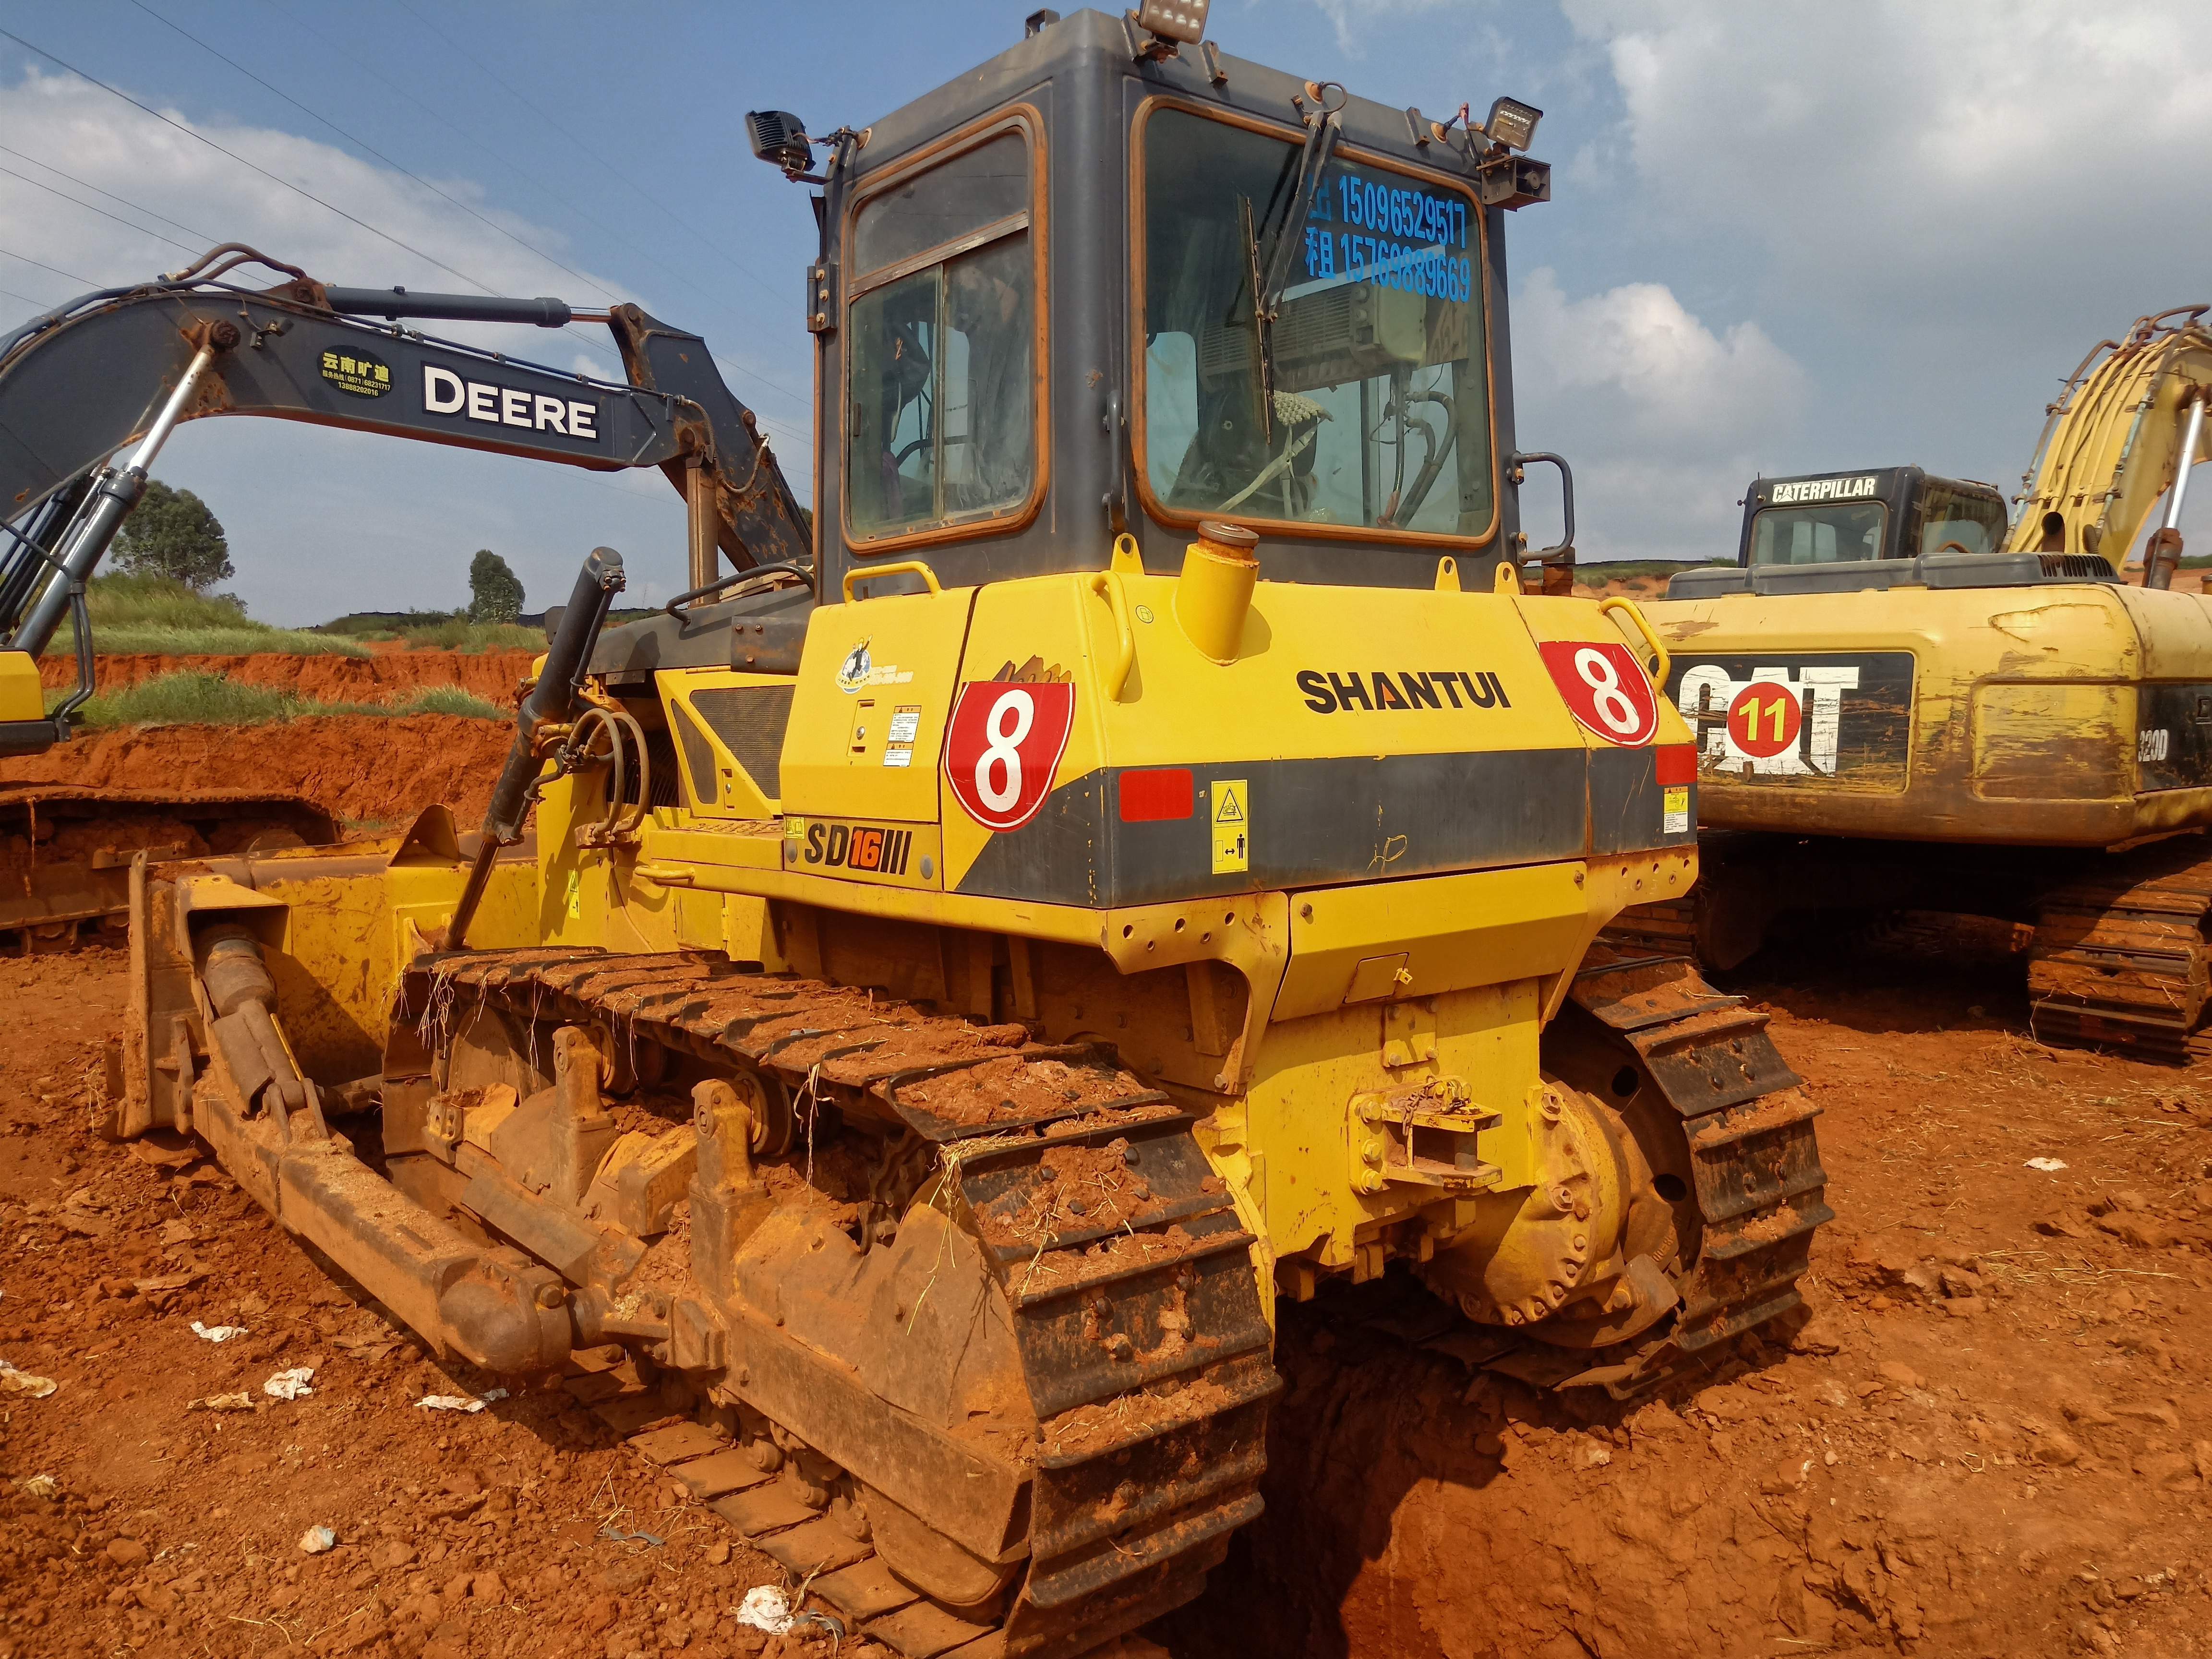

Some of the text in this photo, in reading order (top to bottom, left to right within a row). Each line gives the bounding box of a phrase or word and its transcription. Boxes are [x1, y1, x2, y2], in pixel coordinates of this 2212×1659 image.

[1339, 175, 1466, 249] 15096529517
[1305, 227, 1470, 302] 租 15769889669
[323, 352, 389, 382] 云南旷迪
[338, 382, 379, 396] 13888202016
[425, 366, 596, 439] DEERE
[1772, 478, 1875, 503] CATERPILLAR
[1296, 670, 1512, 714] SHANTUI
[1575, 648, 1640, 734] 8
[1738, 697, 1786, 742] 11
[975, 689, 1034, 812] 8
[2138, 729, 2168, 762] 320D
